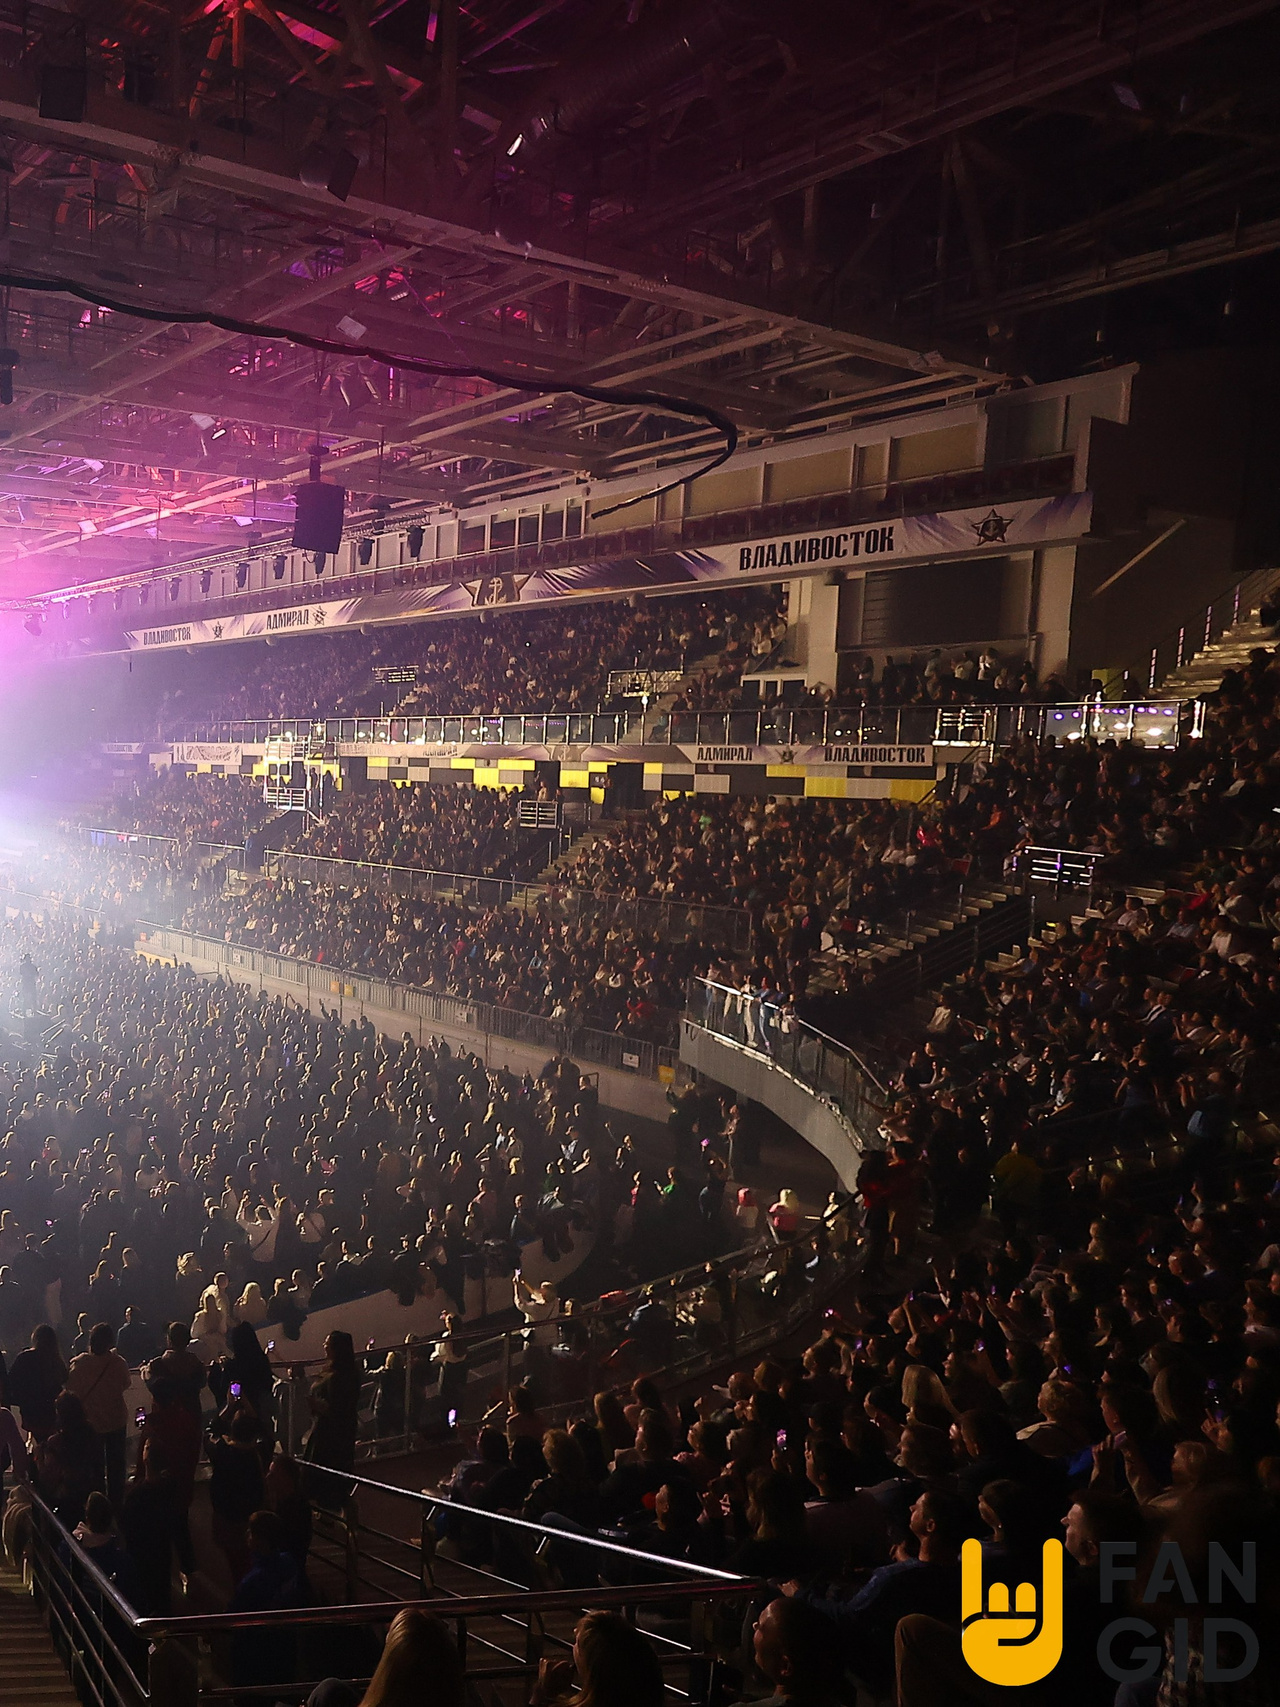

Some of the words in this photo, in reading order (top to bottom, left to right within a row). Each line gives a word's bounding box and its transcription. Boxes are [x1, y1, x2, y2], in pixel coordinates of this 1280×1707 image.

[739, 525, 895, 571] ВЛАДИВОСТОК
[266, 608, 309, 631] АДМИРАЛ
[143, 626, 192, 646] ВЛАДИВОСТОК
[697, 747, 753, 762] АДМИРАЛ
[824, 746, 926, 763] ВЛАДИВОСТОК
